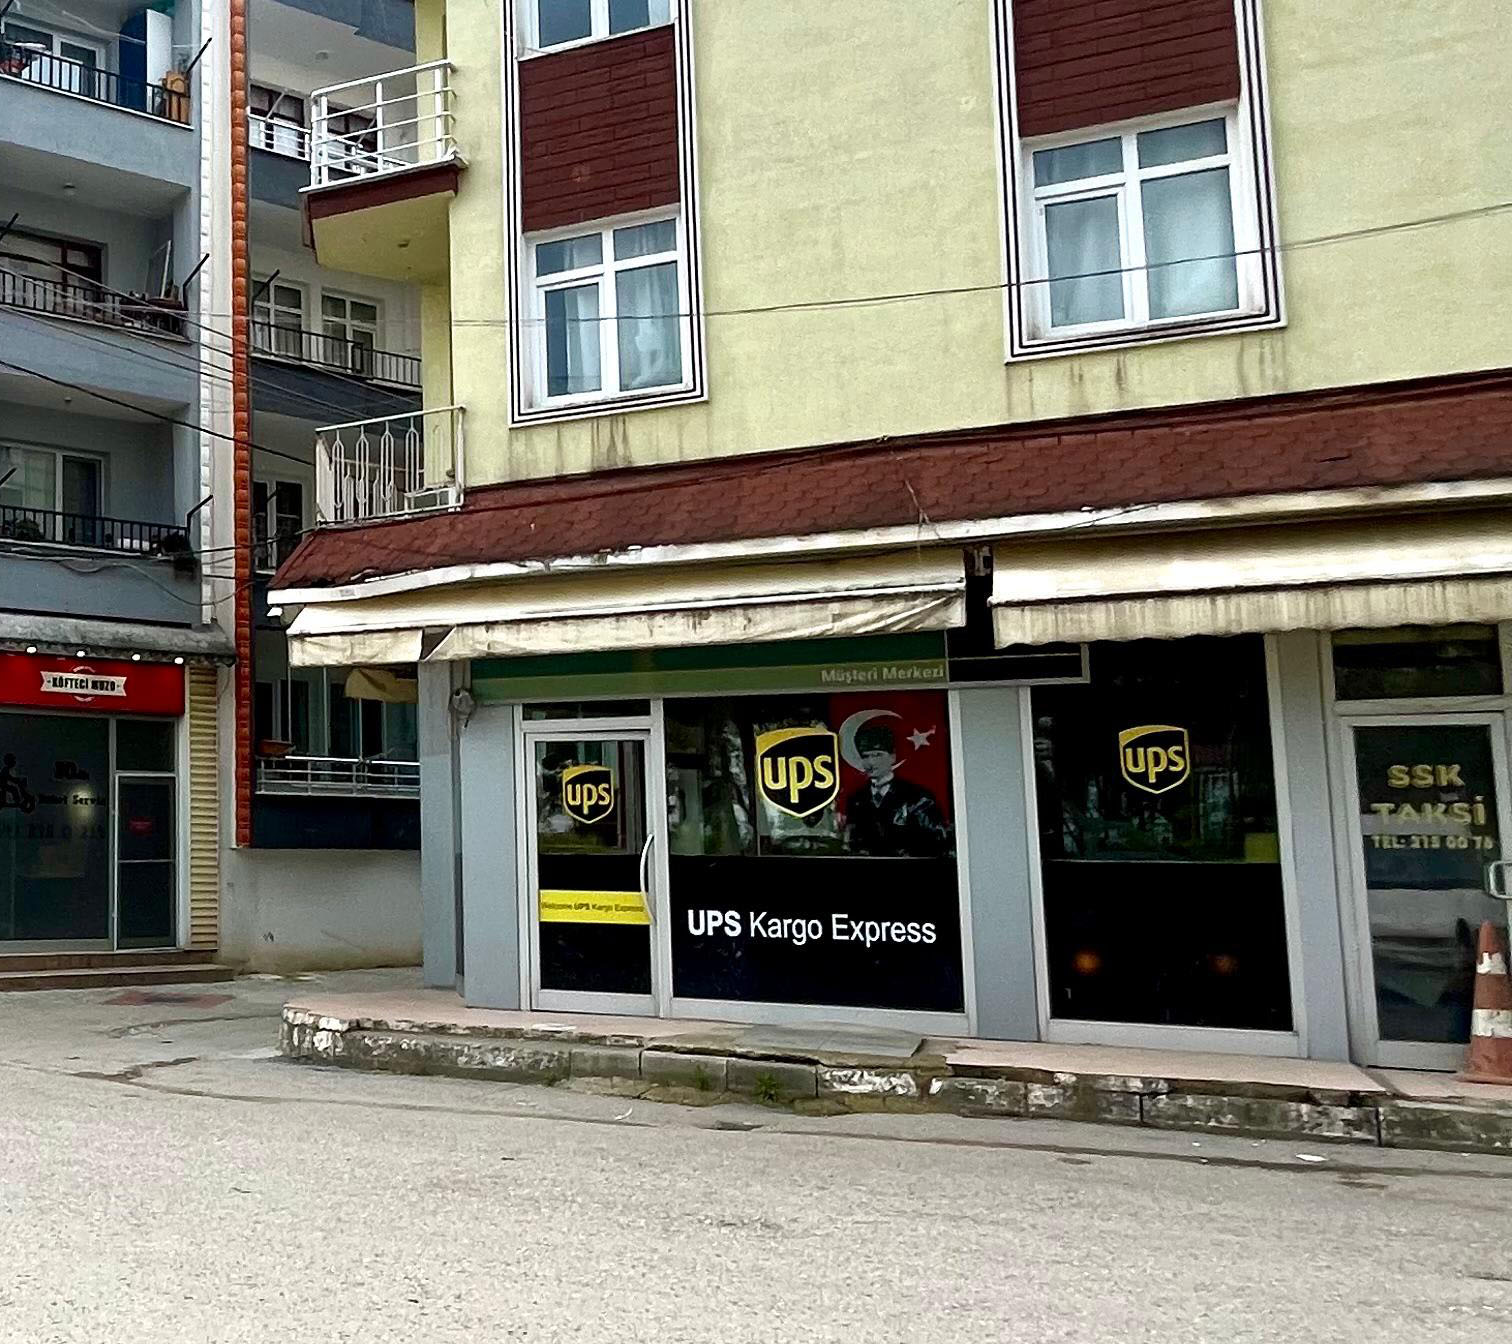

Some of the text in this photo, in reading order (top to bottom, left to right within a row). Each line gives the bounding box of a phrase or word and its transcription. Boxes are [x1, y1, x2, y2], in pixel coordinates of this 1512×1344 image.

[52, 676, 89, 690] KÖFTECİ
[821, 665, 944, 685] Müşteri Merkezi
[1387, 764, 1465, 788] SSK
[1370, 795, 1486, 825] TAKSİ
[688, 909, 937, 948] UPS Kargo Express
